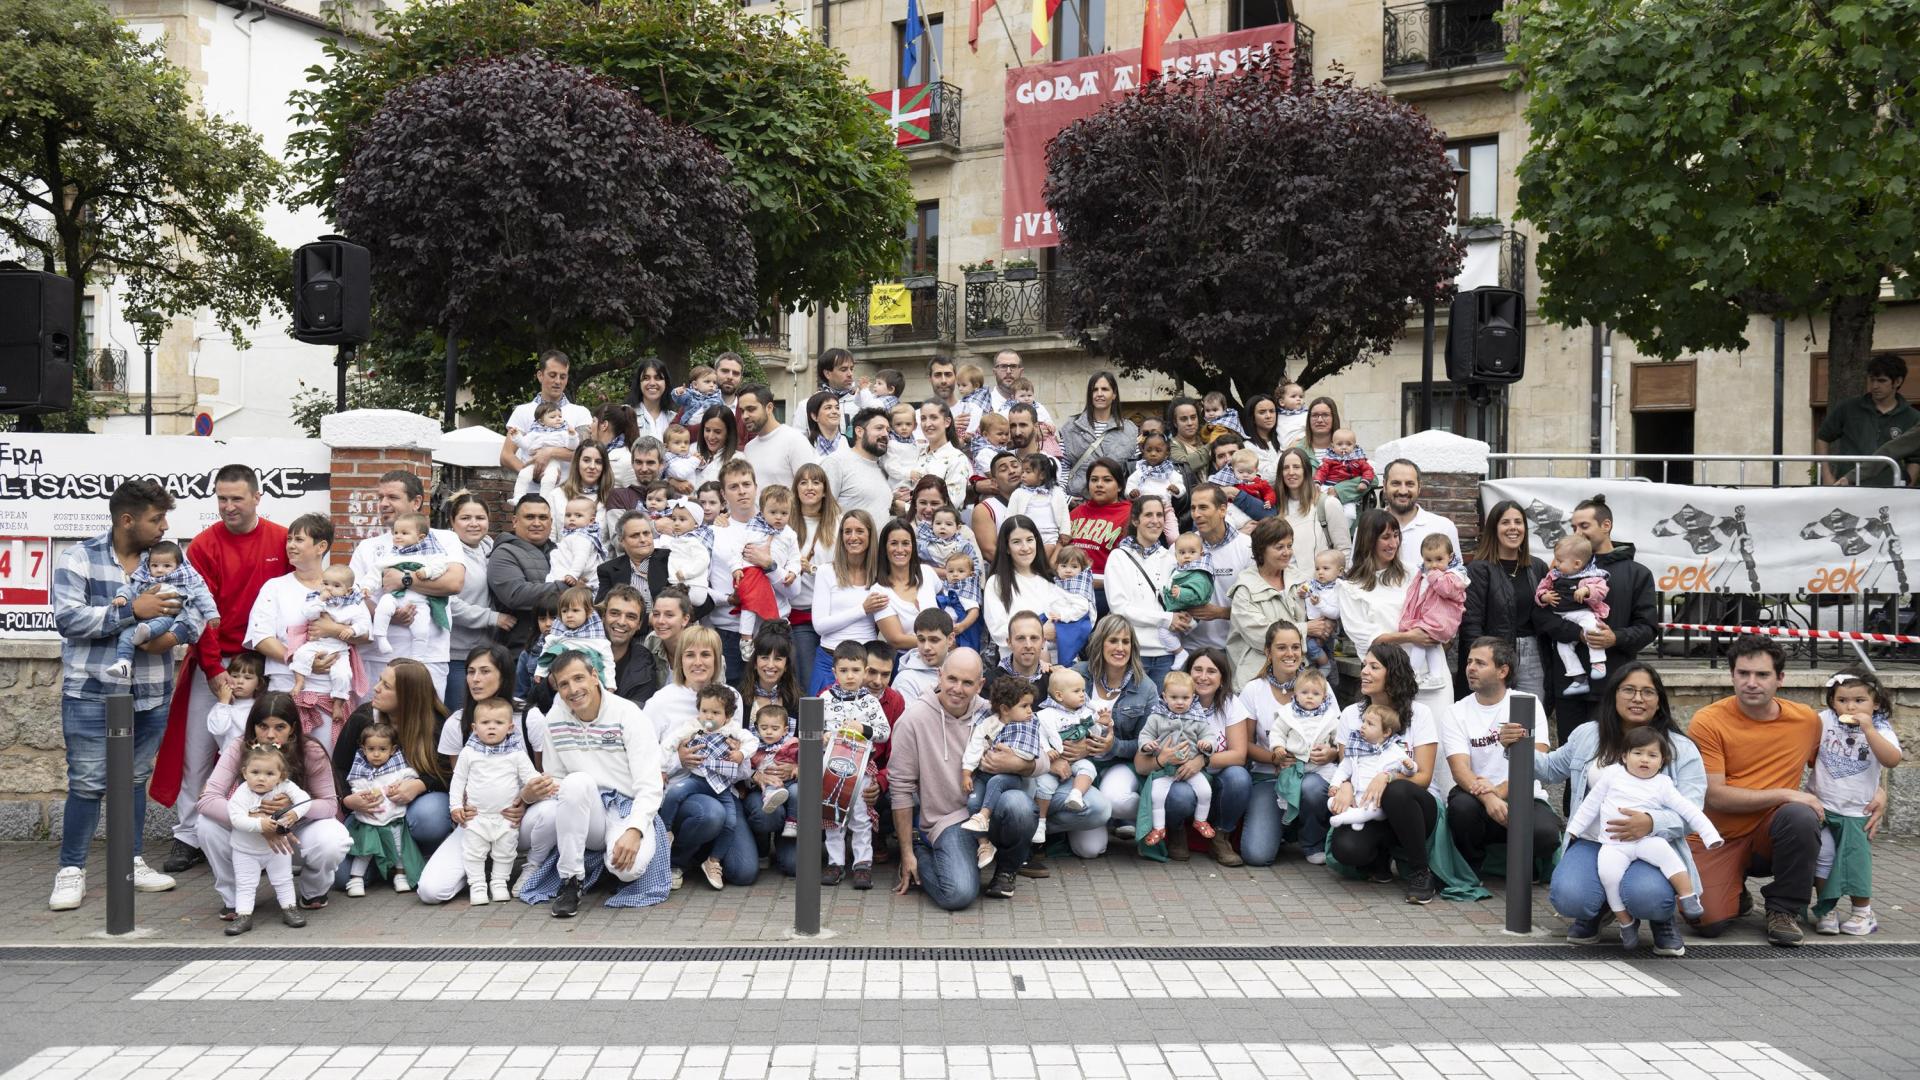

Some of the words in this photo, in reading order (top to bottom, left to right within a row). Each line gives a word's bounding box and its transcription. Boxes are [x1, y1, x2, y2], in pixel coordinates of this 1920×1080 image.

[1016, 71, 1099, 104] GORA
[1014, 211, 1062, 242] ¡Vi
[1658, 557, 1716, 591] aek
[1807, 559, 1866, 593] aek
